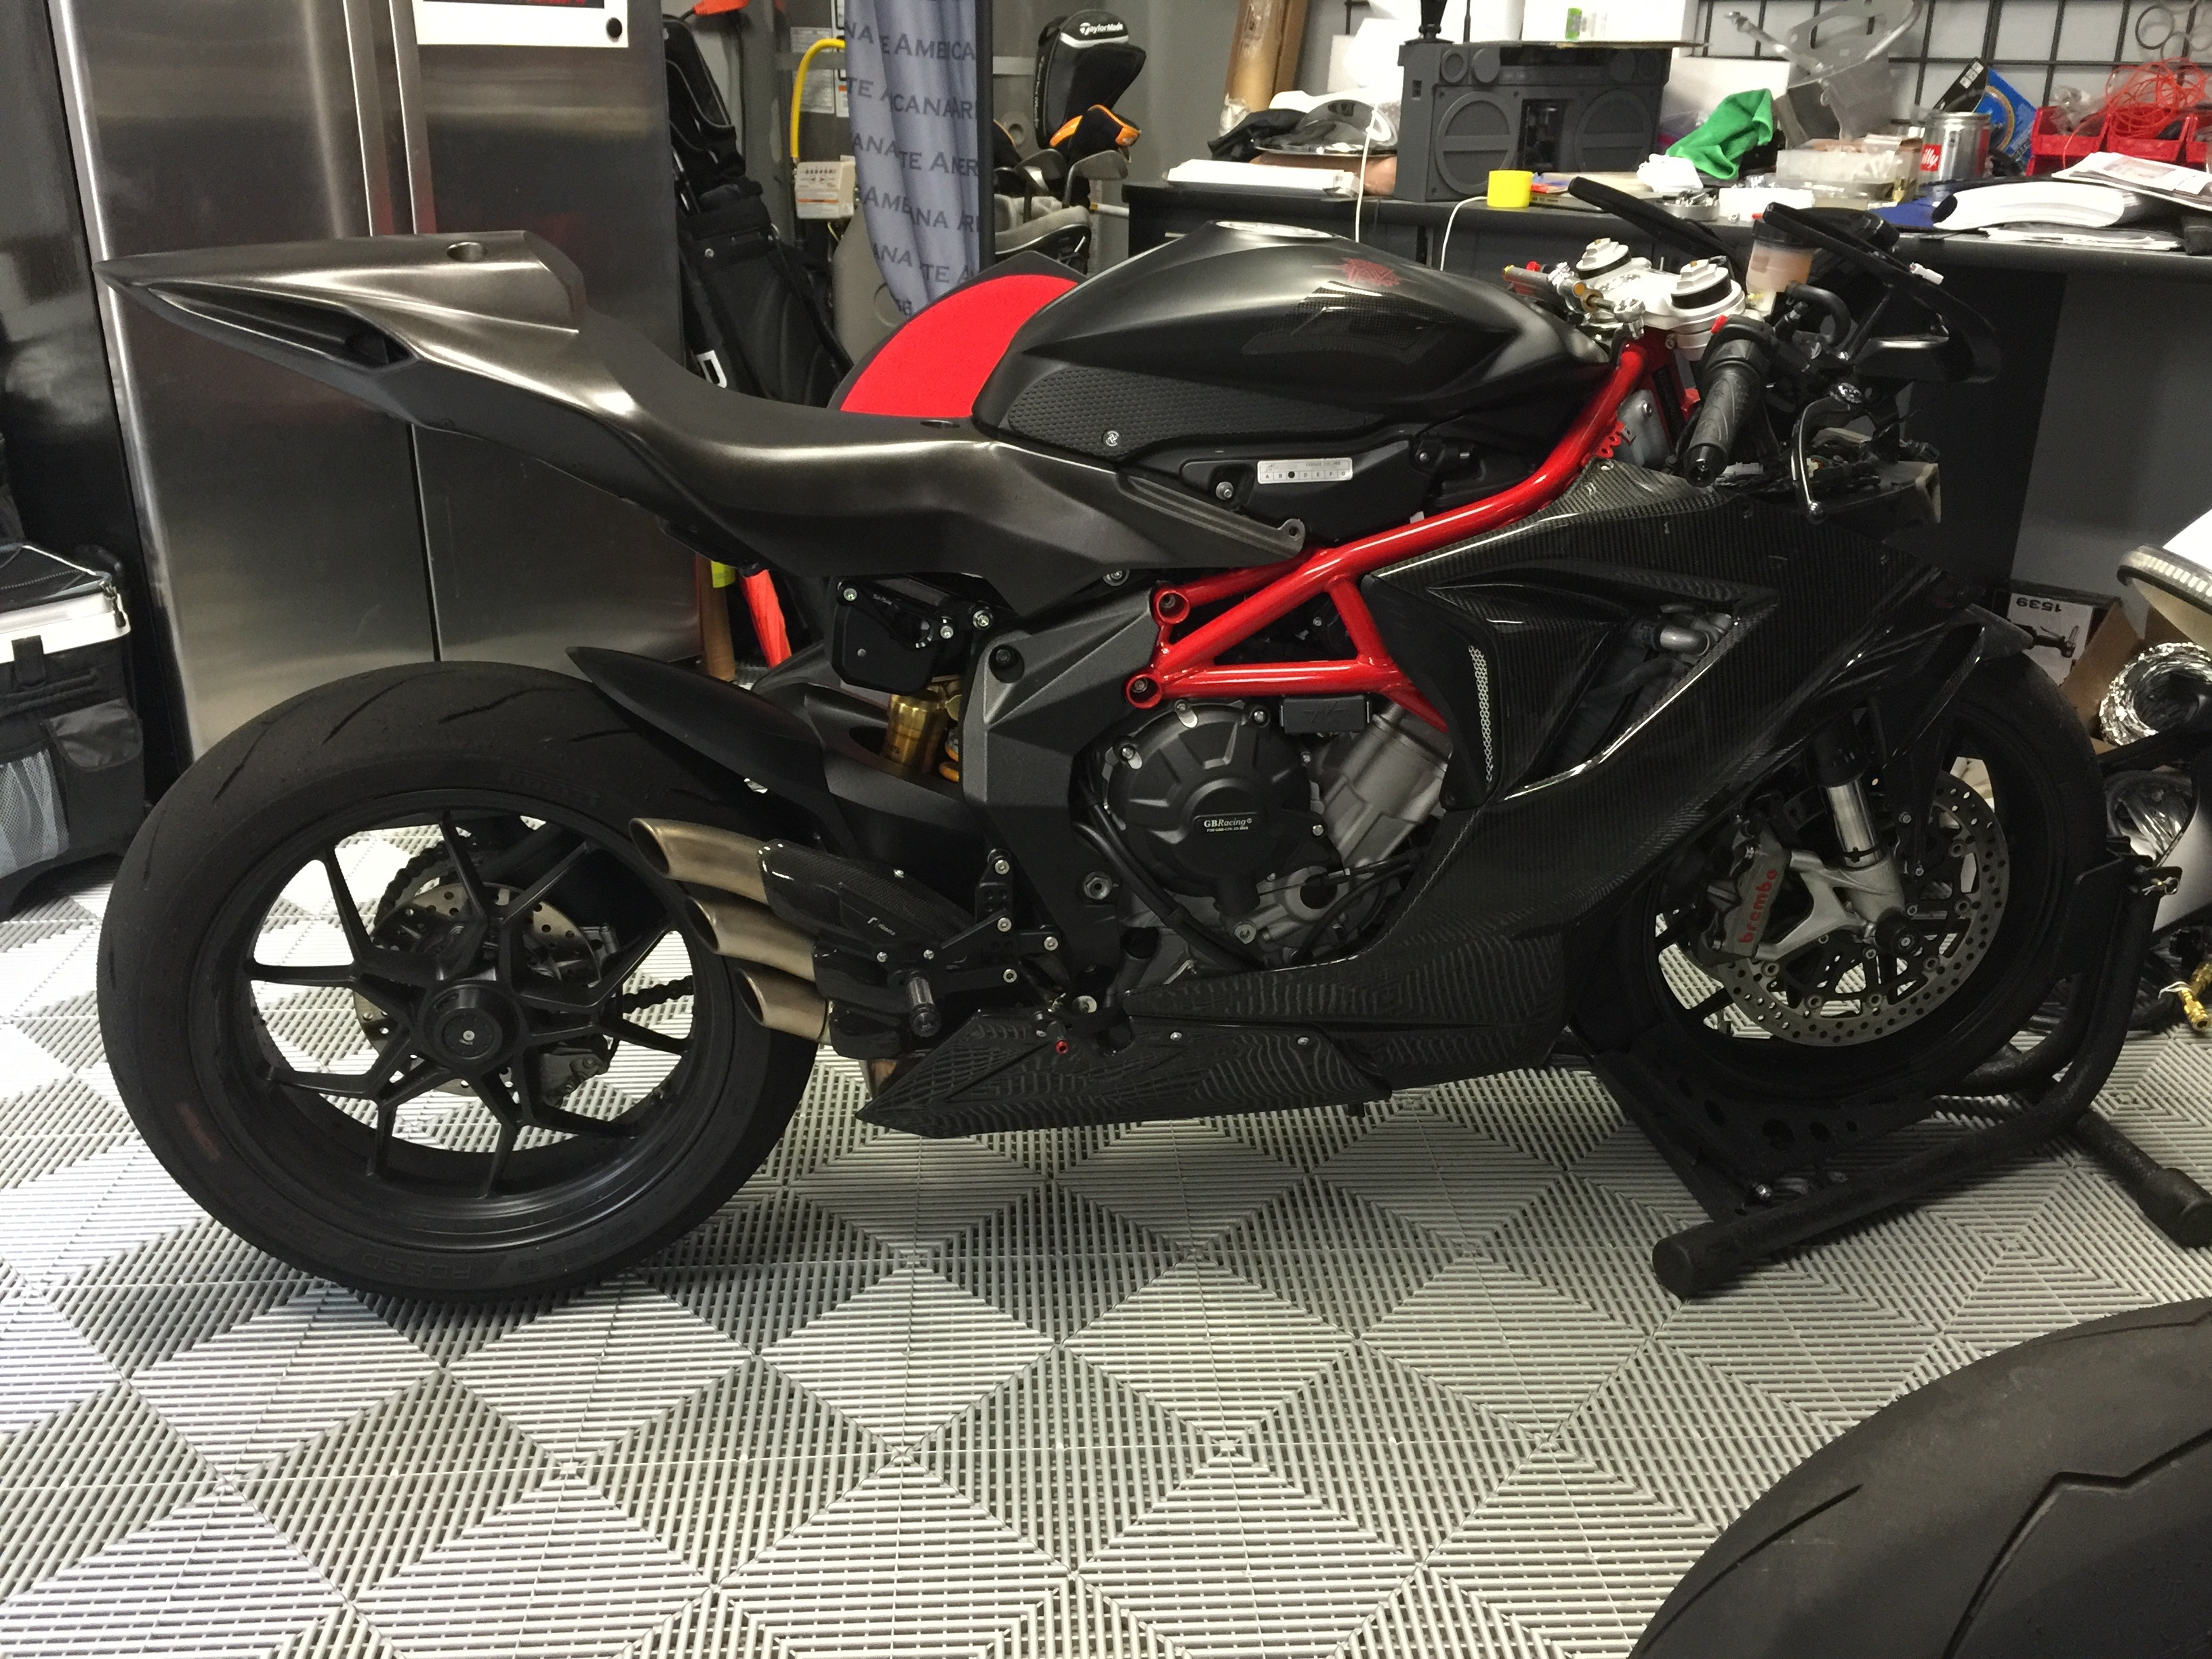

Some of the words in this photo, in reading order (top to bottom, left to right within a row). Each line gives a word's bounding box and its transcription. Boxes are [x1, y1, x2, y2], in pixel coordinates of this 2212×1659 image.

[1079, 22, 1124, 35] TaylorMade
[1921, 148, 1939, 169] illy
[2016, 597, 2062, 613] 1539
[1738, 869, 1778, 943] brembo
